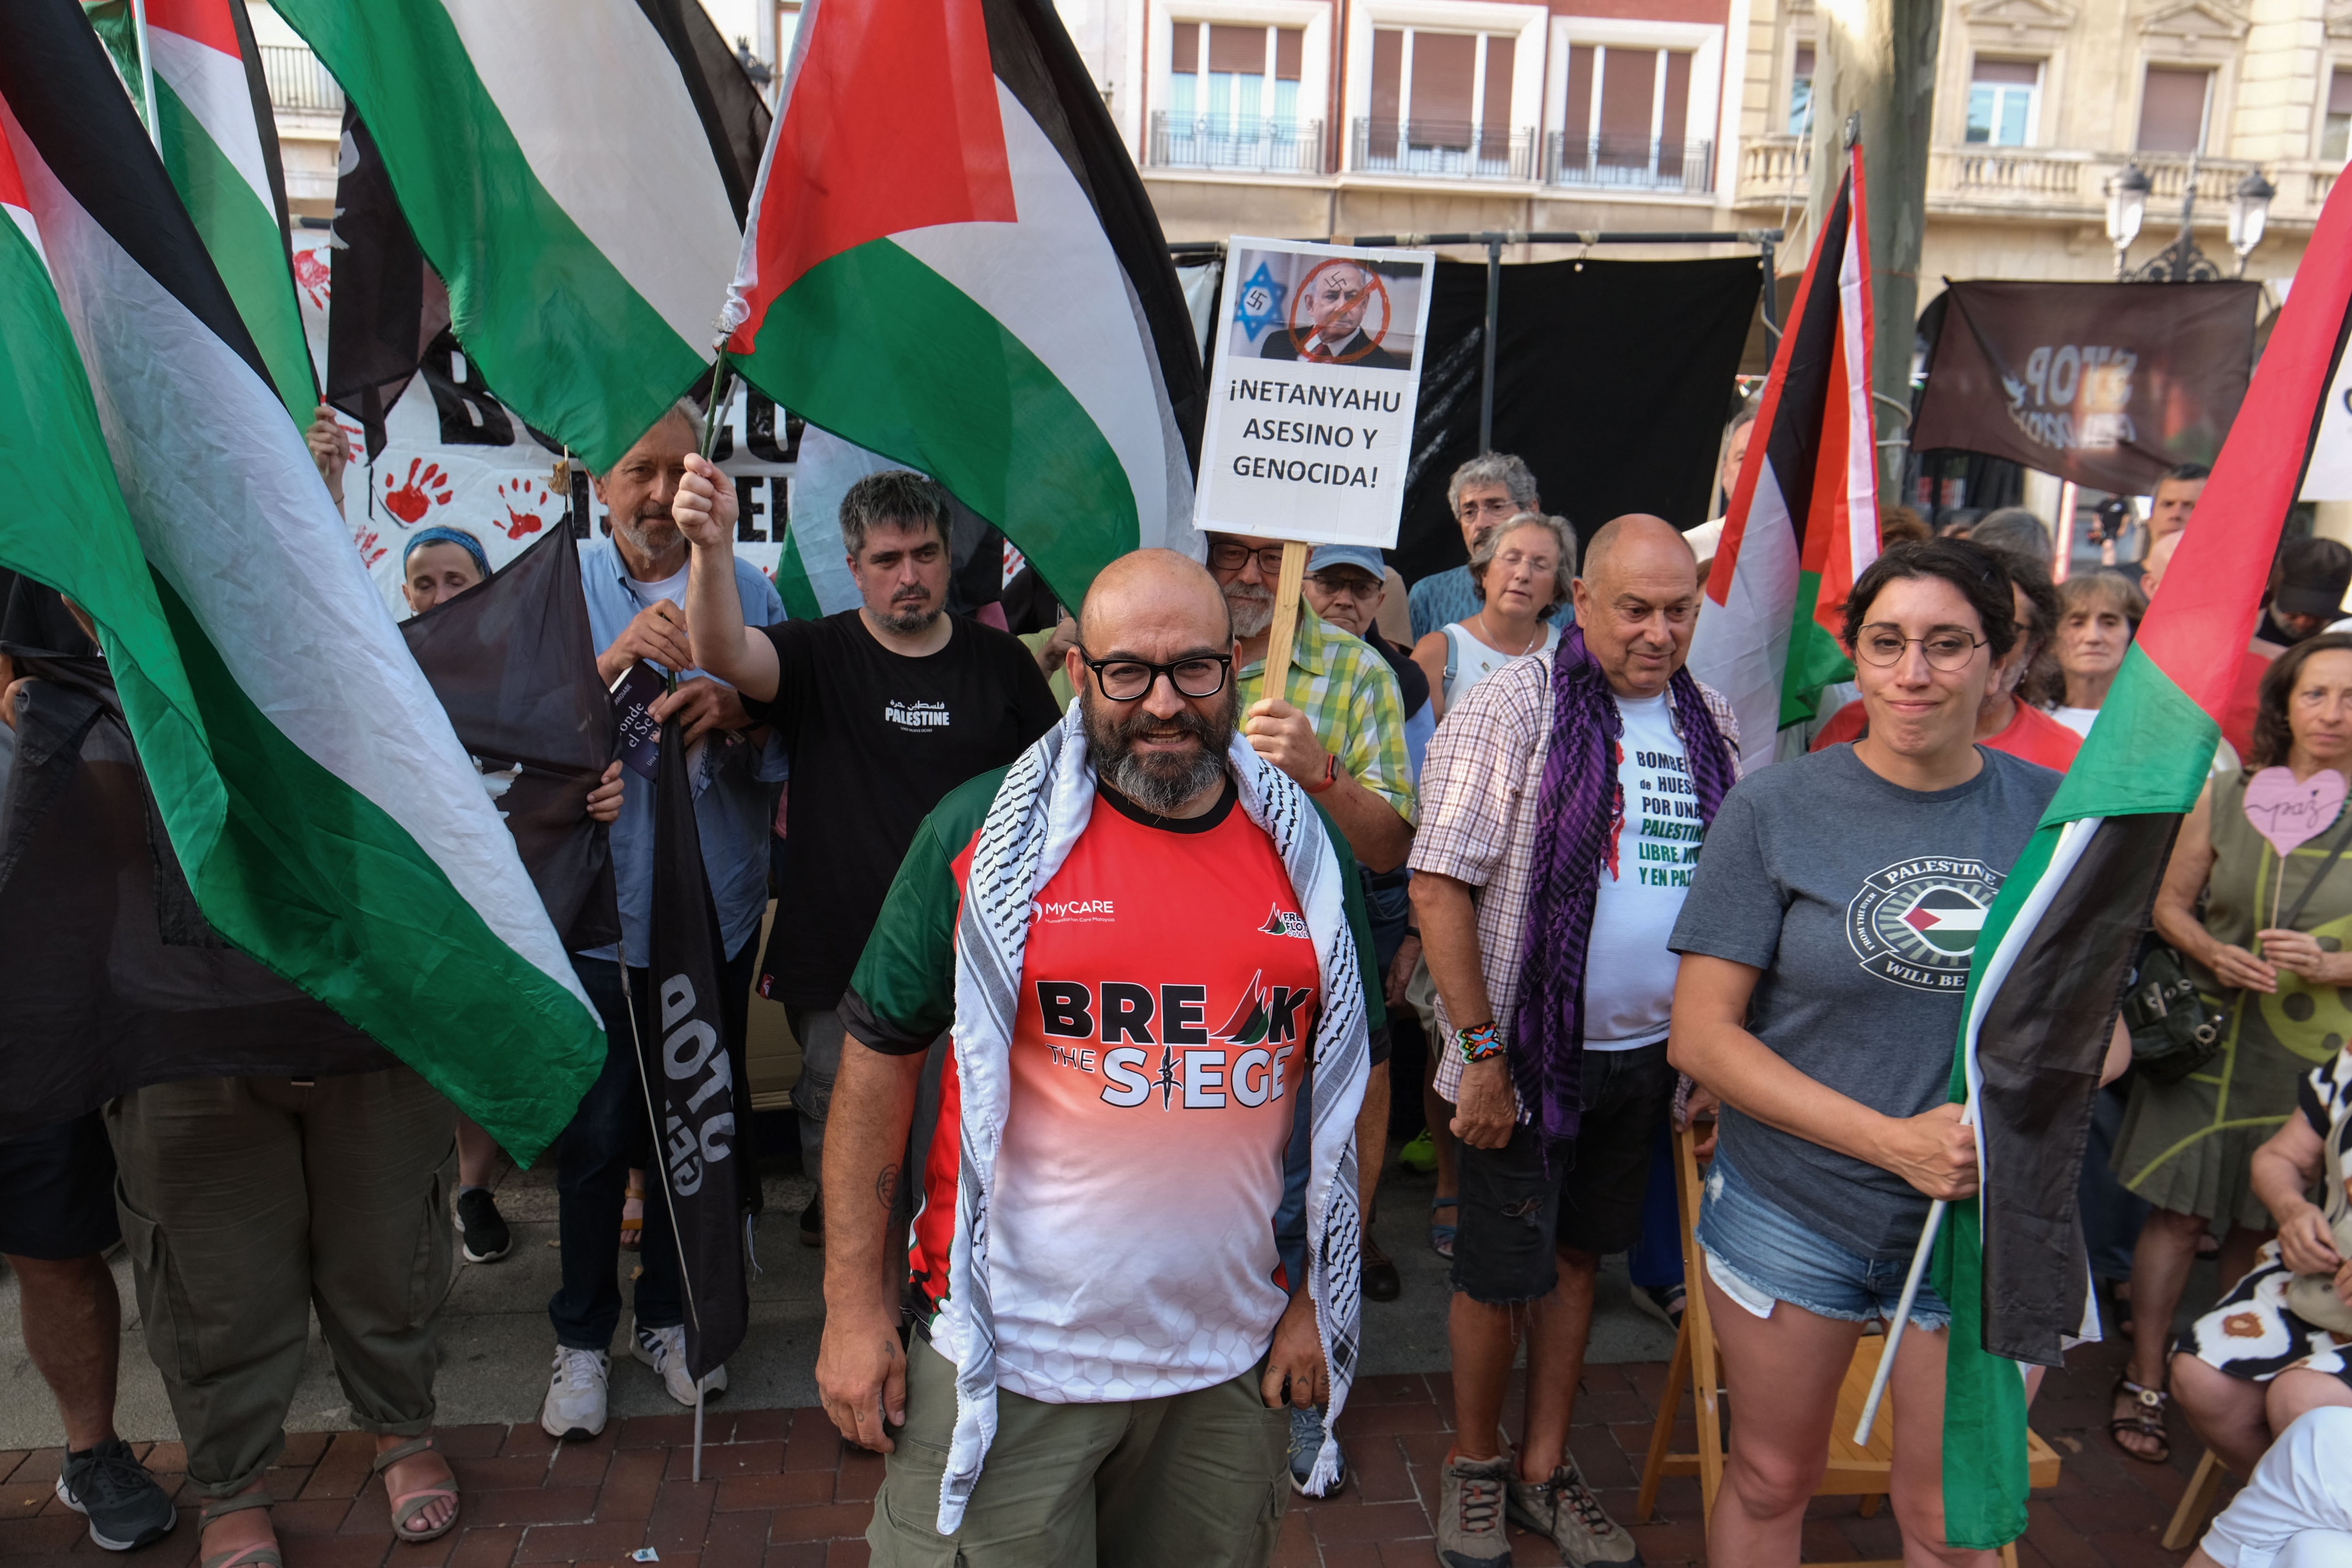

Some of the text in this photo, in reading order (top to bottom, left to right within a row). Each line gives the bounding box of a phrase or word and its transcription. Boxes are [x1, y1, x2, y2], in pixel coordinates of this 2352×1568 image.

[1230, 379, 1401, 413] ¡NETANYAHU
[1243, 418, 1378, 449] ASESINO Y
[1233, 455, 1378, 488] GENOCIDA!
[885, 707, 950, 726] PALESTINE
[907, 700, 945, 711] فلسطين
[620, 702, 644, 736] onde
[628, 733, 640, 748] el
[1636, 751, 1685, 772] BOMBE
[1640, 776, 1692, 795] de HUES
[1642, 796, 1702, 820] POR UNA
[1640, 818, 1704, 842] PALESTIN
[1639, 867, 1647, 884] Y
[1651, 868, 1667, 886] EN
[1884, 860, 1997, 885] PALESTINE
[1045, 900, 1114, 917] MyCARE
[1283, 913, 1306, 922] FRE
[1857, 908, 1866, 926] THE
[1286, 922, 1309, 933] FLOT
[1857, 927, 1876, 951] FROM
[1885, 961, 1965, 987] WILL BE
[1045, 1043, 1097, 1073] THE
